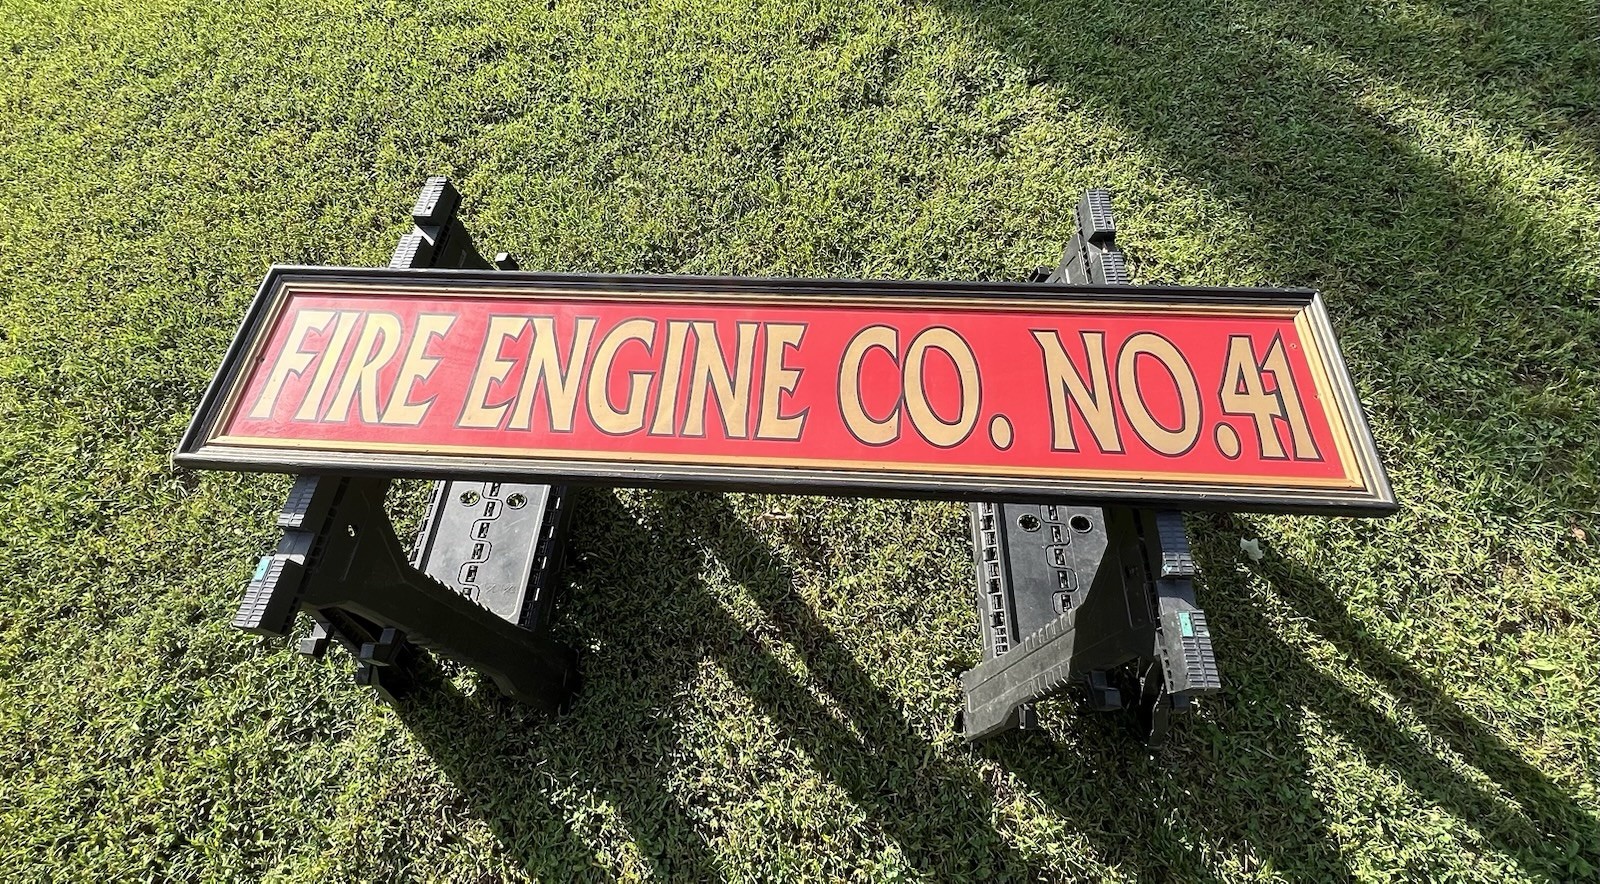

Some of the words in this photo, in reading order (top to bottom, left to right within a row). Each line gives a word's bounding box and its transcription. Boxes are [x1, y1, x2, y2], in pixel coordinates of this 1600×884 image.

[247, 309, 457, 427] FIRE
[456, 314, 808, 442] ENGINE
[838, 324, 1014, 451] CO.
